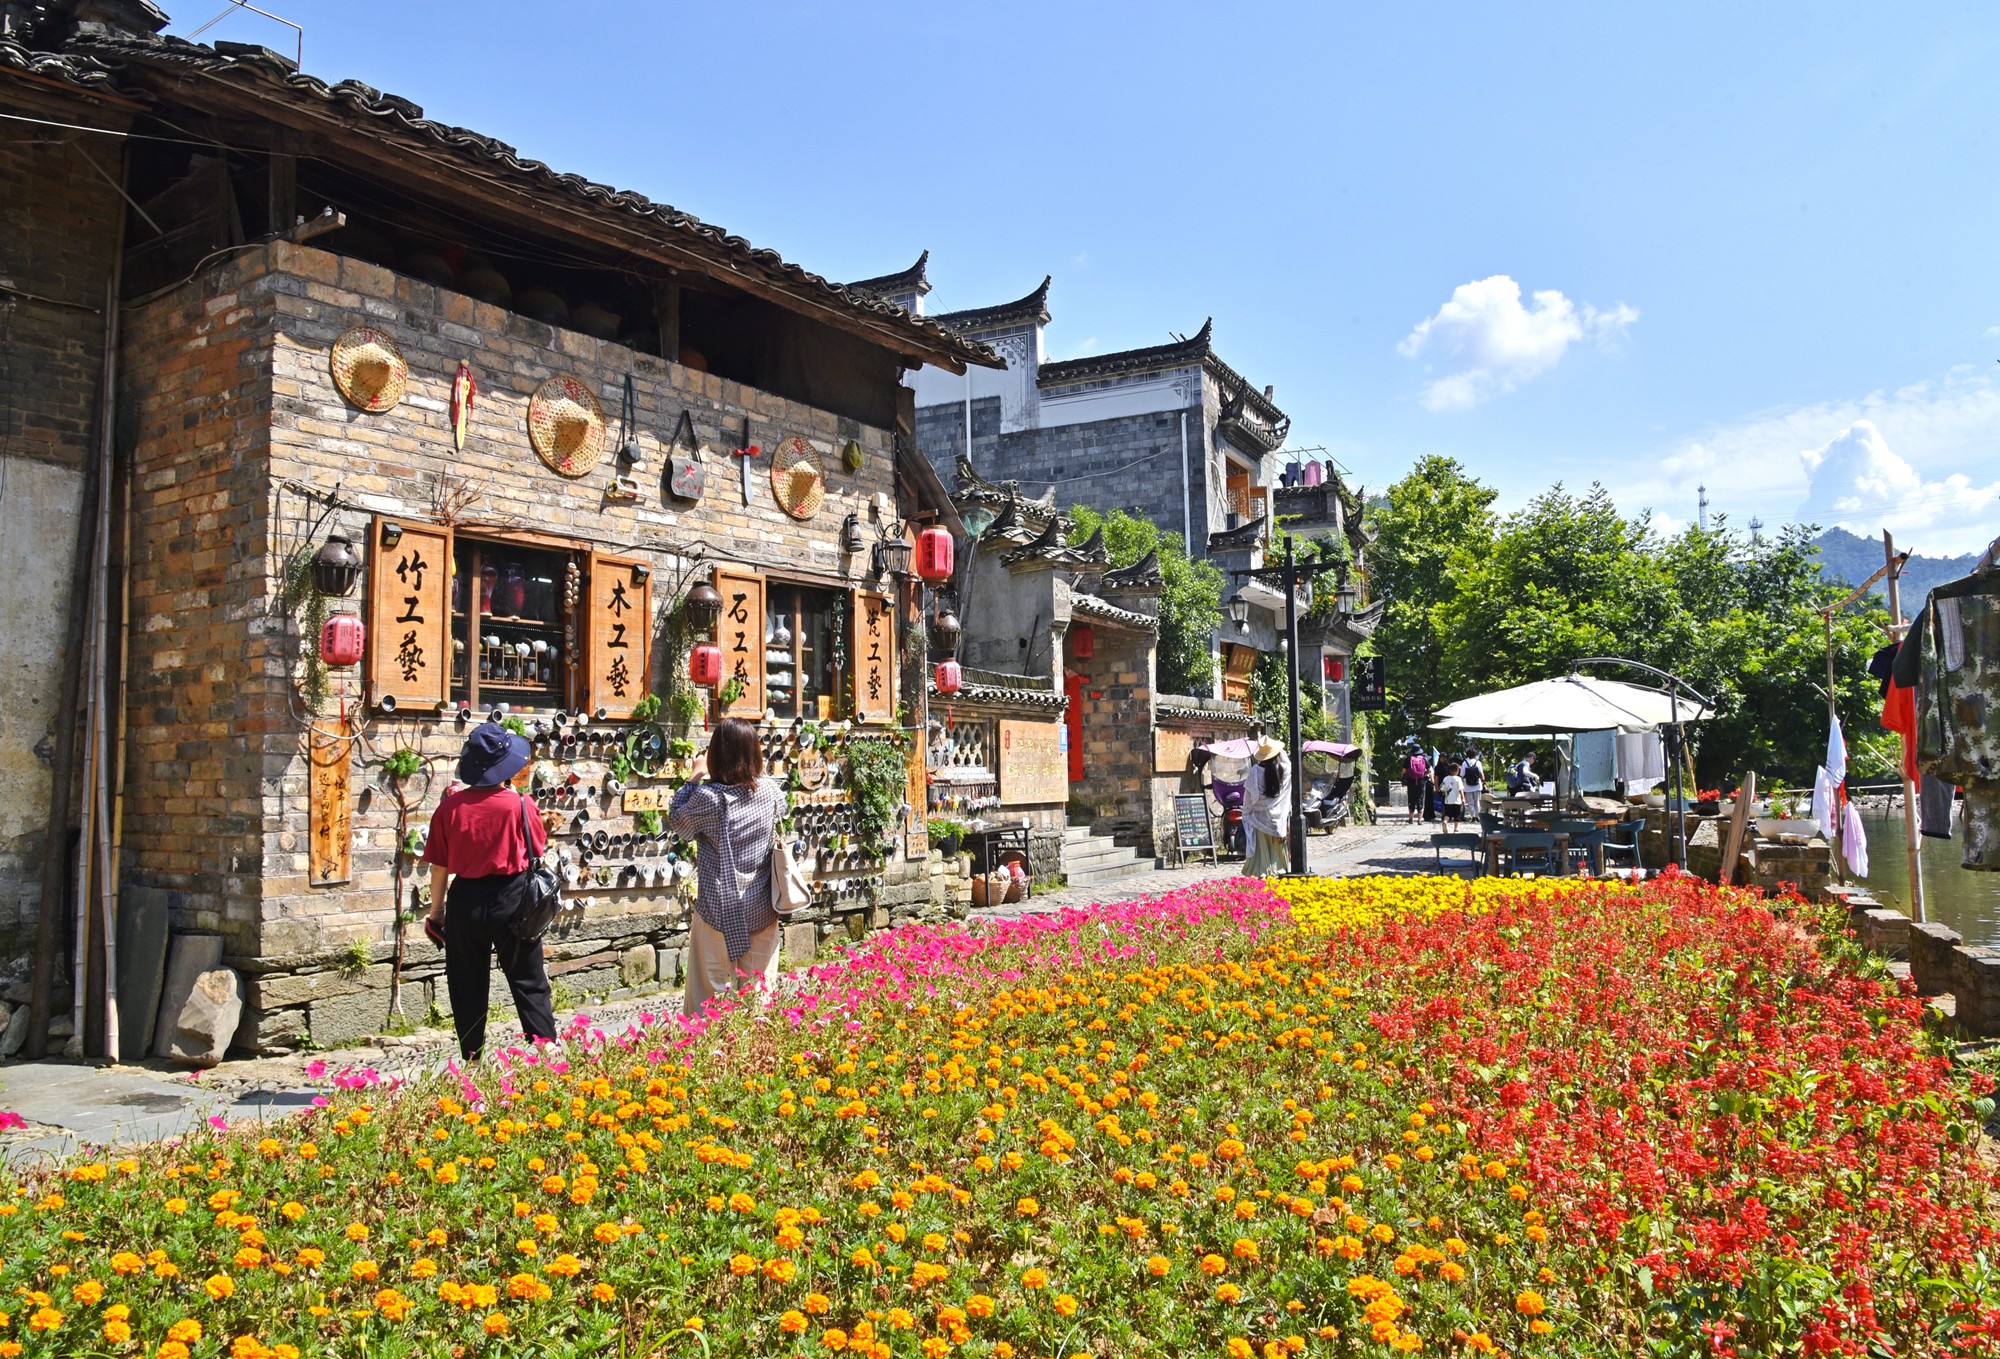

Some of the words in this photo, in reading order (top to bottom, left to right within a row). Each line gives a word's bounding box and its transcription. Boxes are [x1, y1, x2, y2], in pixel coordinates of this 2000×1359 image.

[394, 550, 427, 683] 竹工藝
[606, 579, 632, 698] 木工藝
[727, 593, 750, 699] 石工藝
[931, 748, 949, 767] 有店
